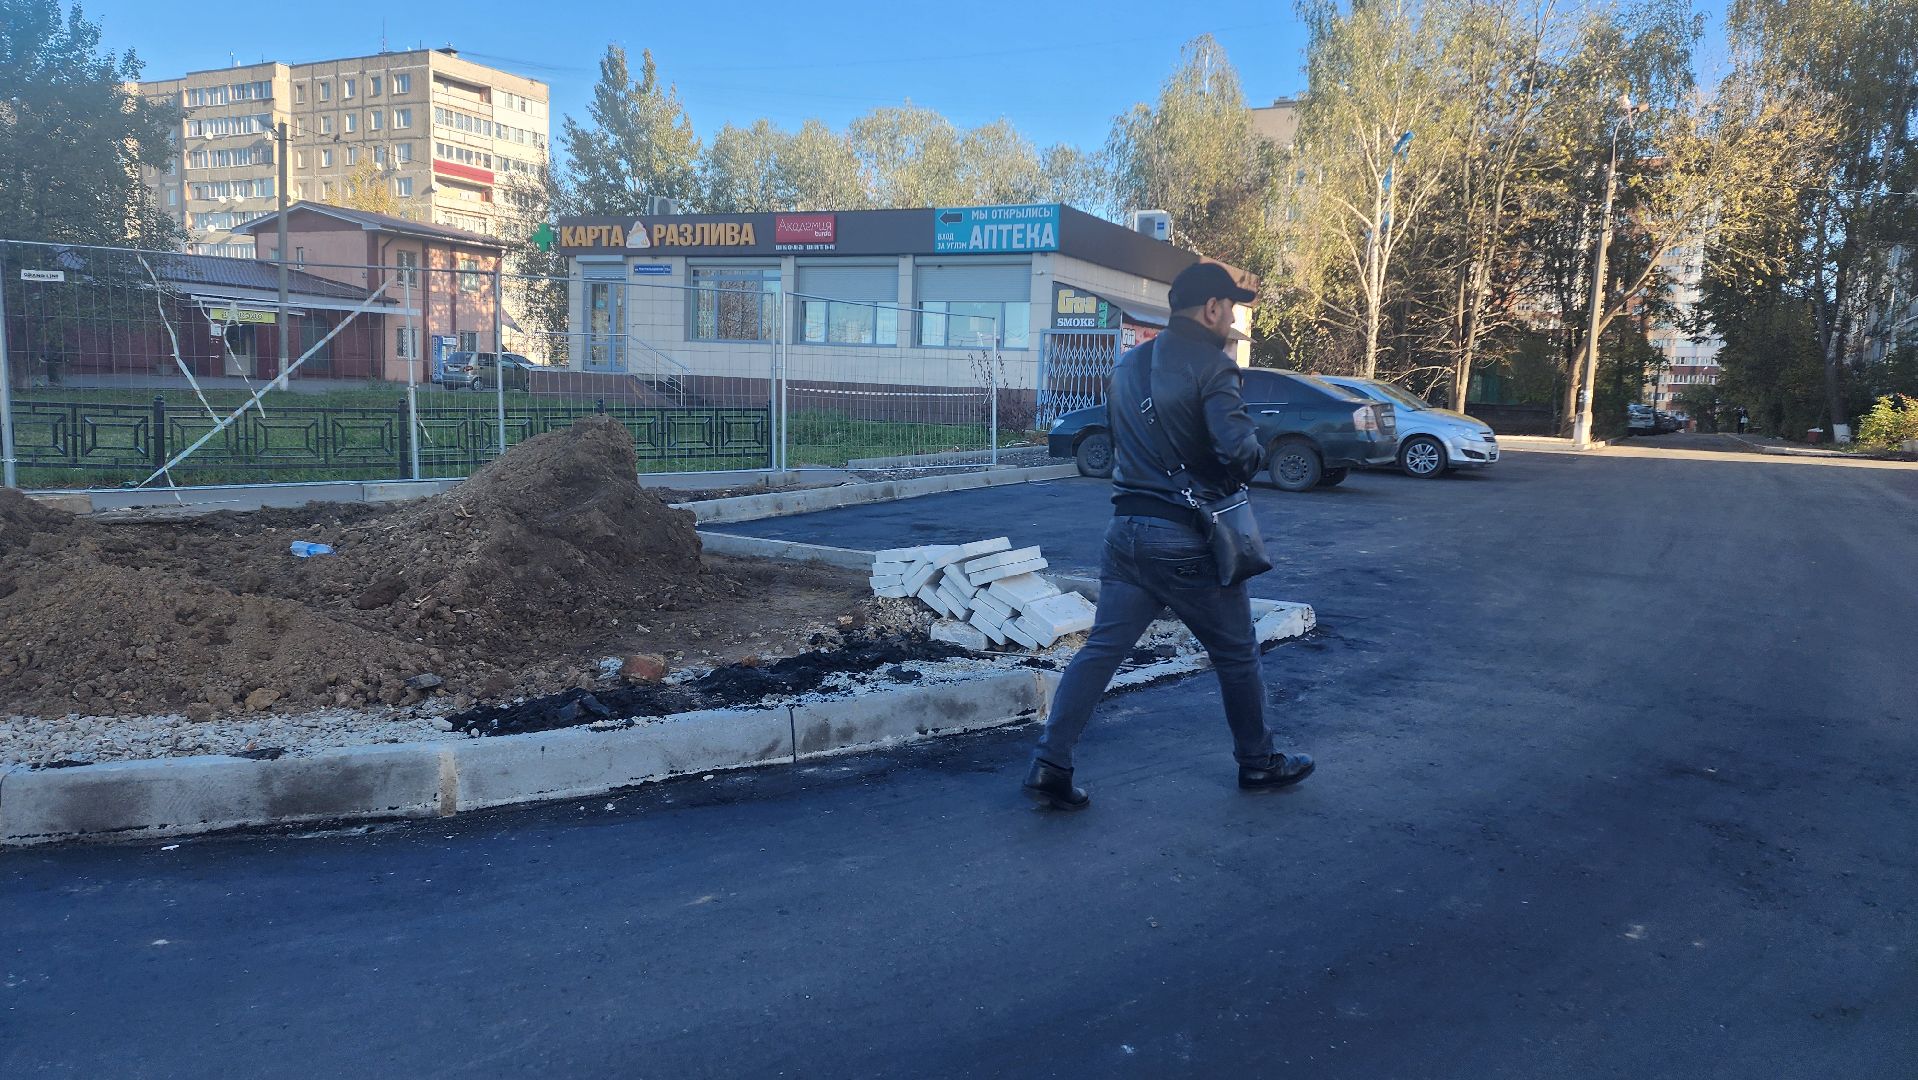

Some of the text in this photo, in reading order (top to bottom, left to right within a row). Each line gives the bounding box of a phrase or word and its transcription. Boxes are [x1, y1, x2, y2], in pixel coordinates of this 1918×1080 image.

[971, 207, 1053, 220] МЫ ОТКРЫЛИСЬ!
[561, 222, 756, 248] КАРТА РАЗЛИВА
[937, 233, 954, 241] ВХОД
[969, 223, 1055, 249] АПТЕКА
[937, 242, 945, 250] ЗА
[1056, 317, 1095, 327] SMOKE
